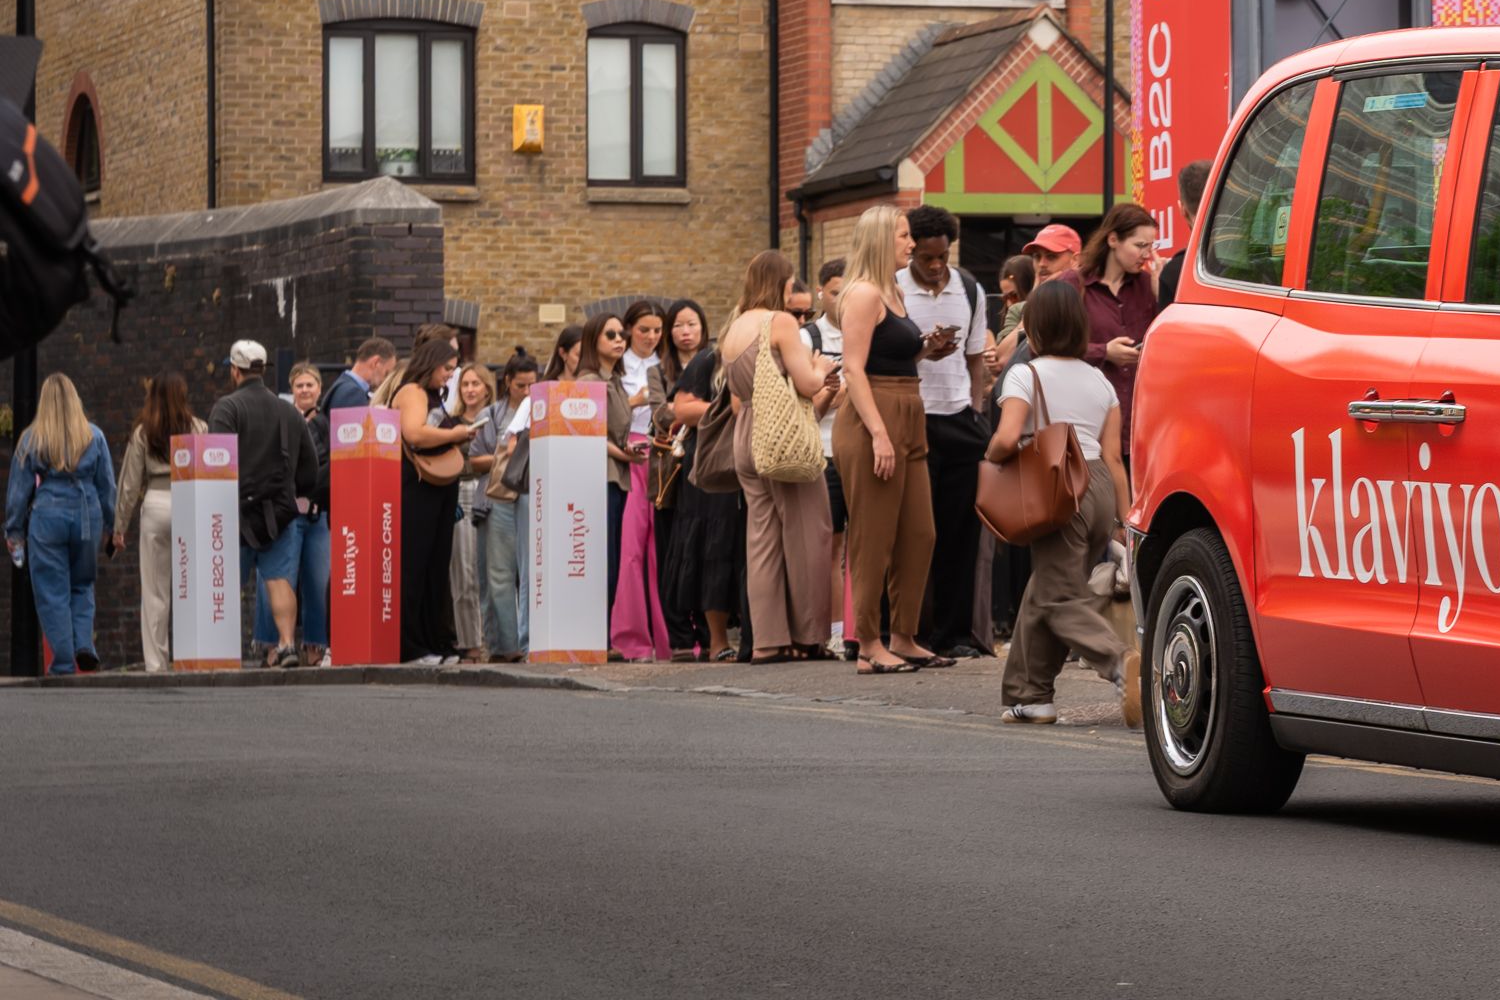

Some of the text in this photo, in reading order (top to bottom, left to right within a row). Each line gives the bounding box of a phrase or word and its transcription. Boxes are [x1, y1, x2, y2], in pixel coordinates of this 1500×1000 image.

[1147, 20, 1174, 181] B2C
[211, 513, 225, 624] THE B2C CRM
[342, 530, 359, 596] klaviyo
[382, 502, 393, 623] THE B2C CRM
[567, 508, 590, 578] klaviyo
